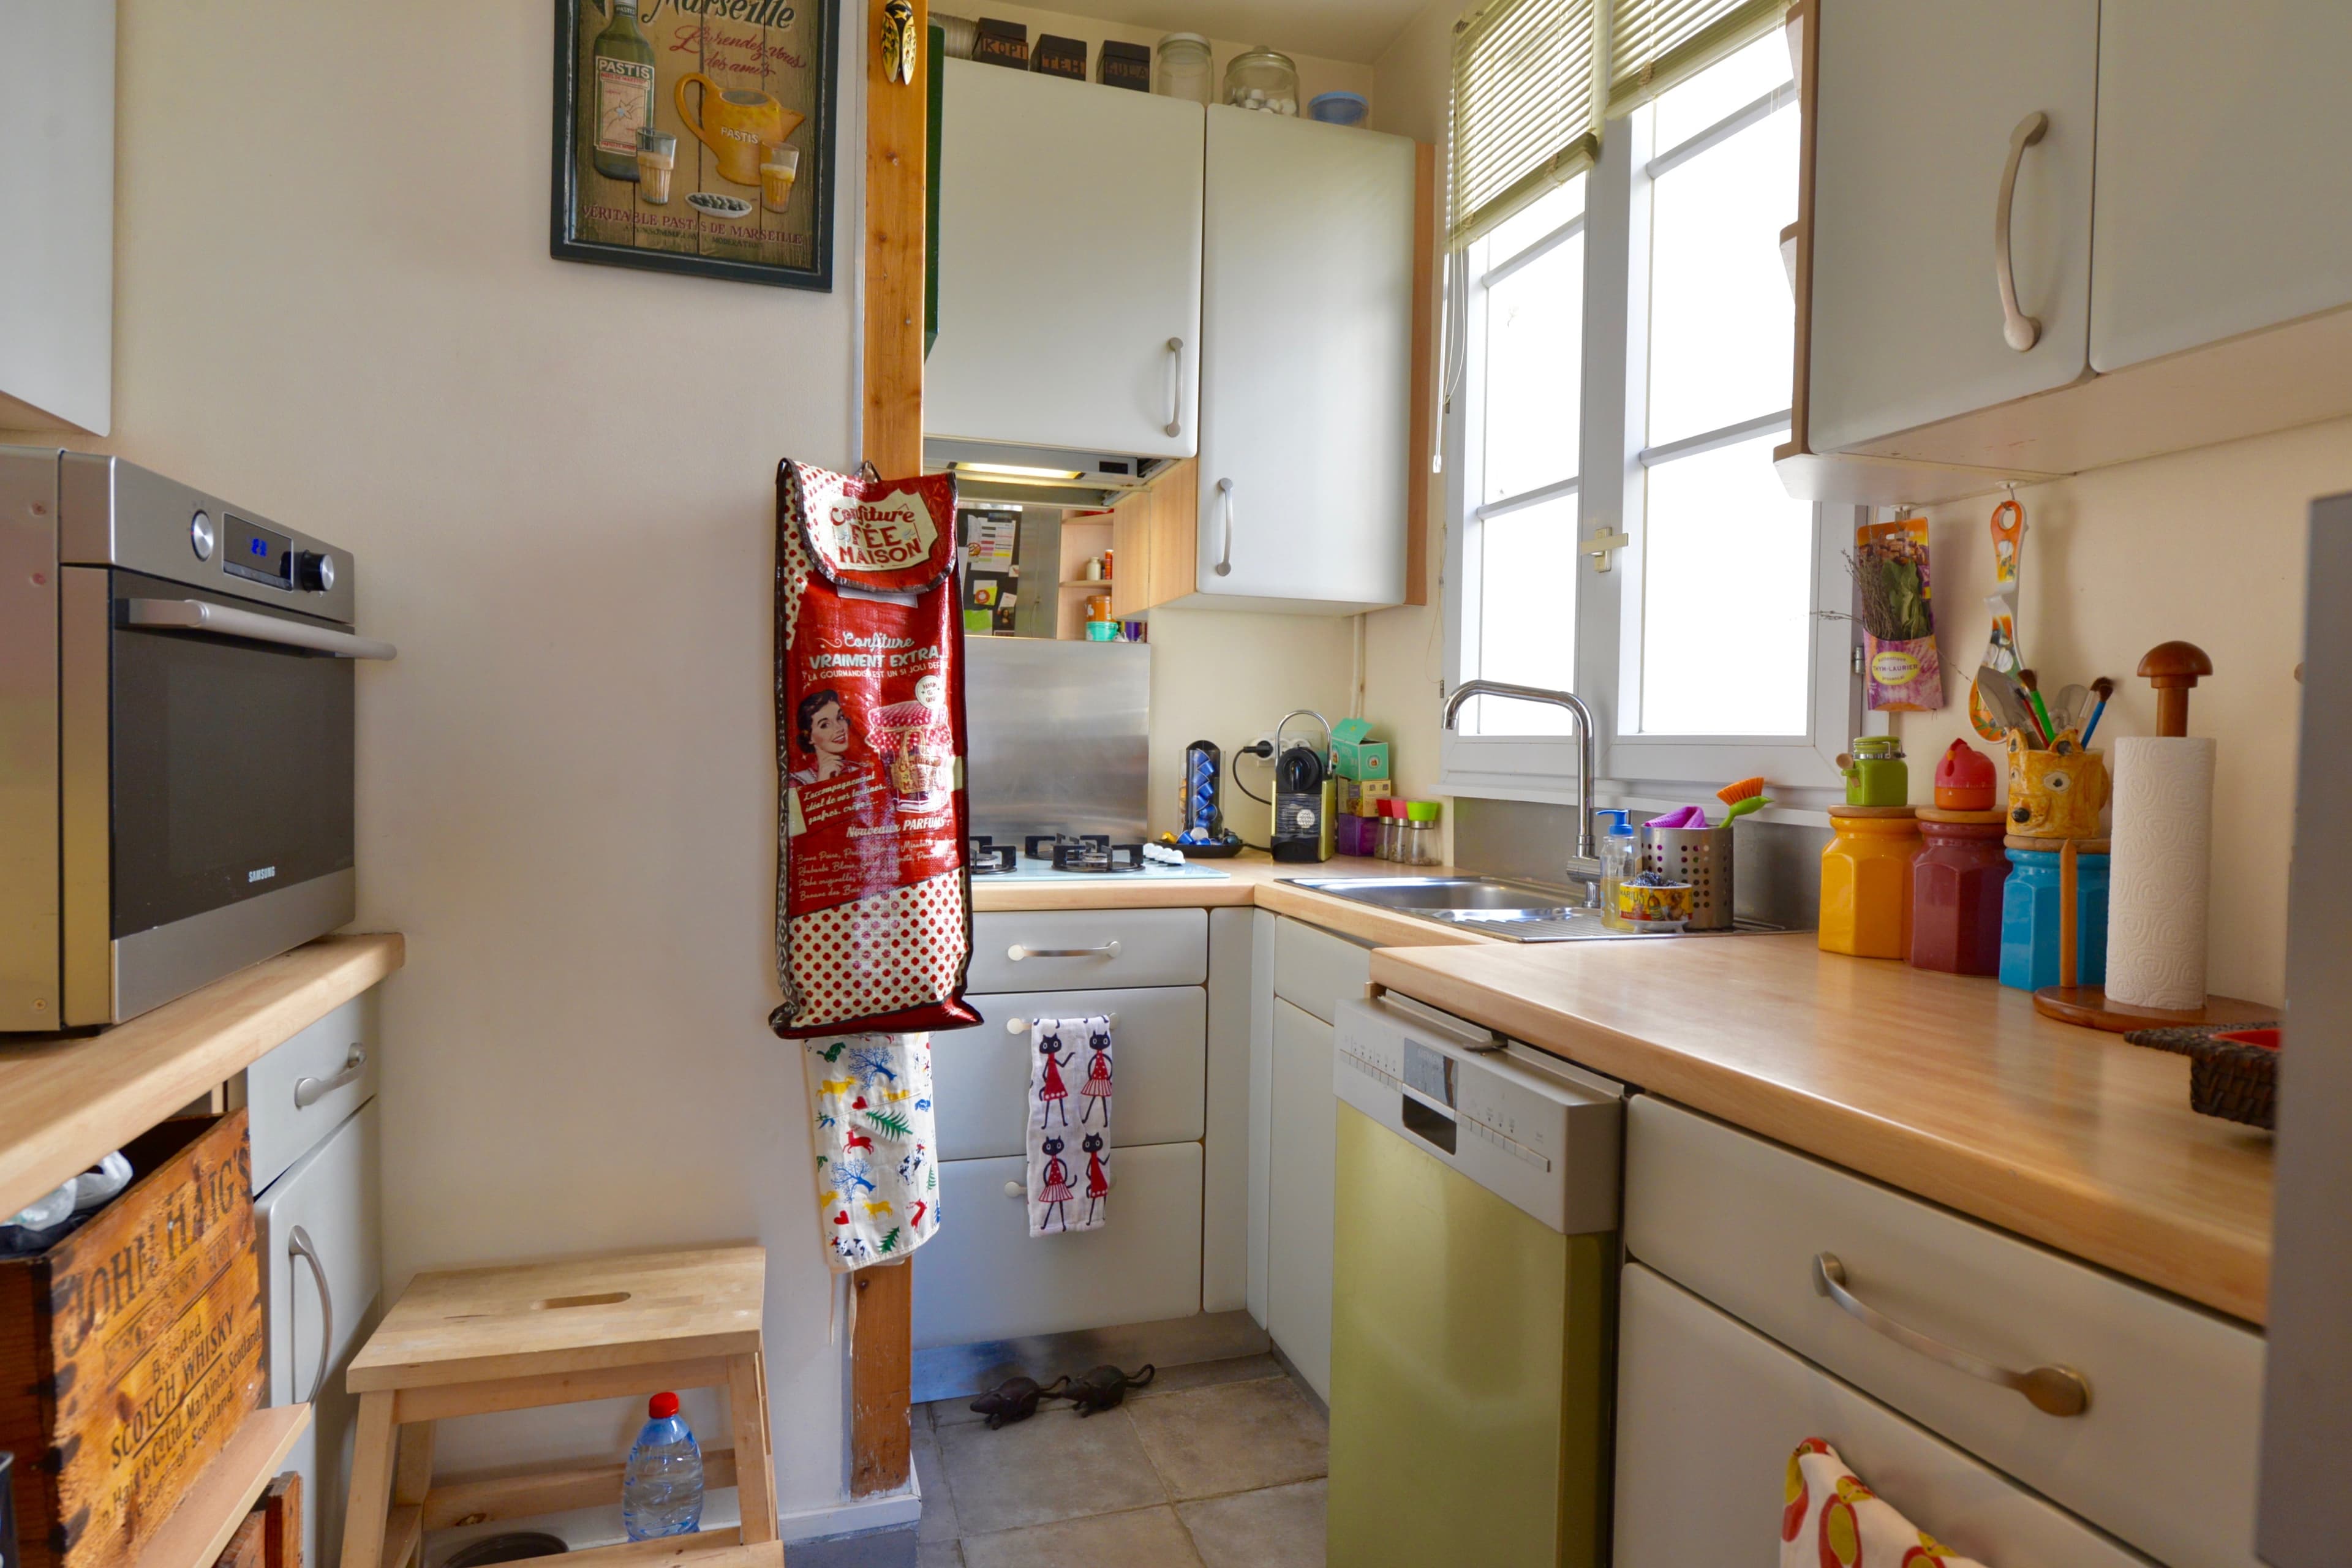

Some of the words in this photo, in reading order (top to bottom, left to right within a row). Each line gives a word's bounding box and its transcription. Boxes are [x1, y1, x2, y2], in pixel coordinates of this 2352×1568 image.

[984, 38, 1025, 59] KOPI
[598, 59, 650, 79] PASTIS
[704, 51, 726, 70] des
[728, 61, 776, 77] amis
[1043, 53, 1084, 74] TEH
[721, 126, 759, 144] PASTIS
[662, 216, 706, 233] PASTIS
[710, 221, 726, 234] DE
[730, 225, 804, 245] MARSEILLE
[830, 505, 915, 526] Confiture
[850, 523, 902, 548] FÉE
[839, 538, 923, 565] MAISON
[842, 631, 915, 652] Confiture
[809, 653, 886, 669] VRAIMENT
[808, 674, 818, 682] LA
[820, 668, 872, 679] GOURMANDIS
[872, 670, 884, 679] EST
[900, 667, 907, 676] SI
[909, 663, 926, 674] JOLI
[805, 797, 825, 812] idéal
[827, 796, 836, 805] de
[837, 793, 850, 802] vos
[846, 823, 901, 838] Nouveaux
[249, 865, 275, 883] SAMSUNG
[111, 1373, 176, 1469] SCOTCH
[183, 1304, 235, 1385] WHISKY
